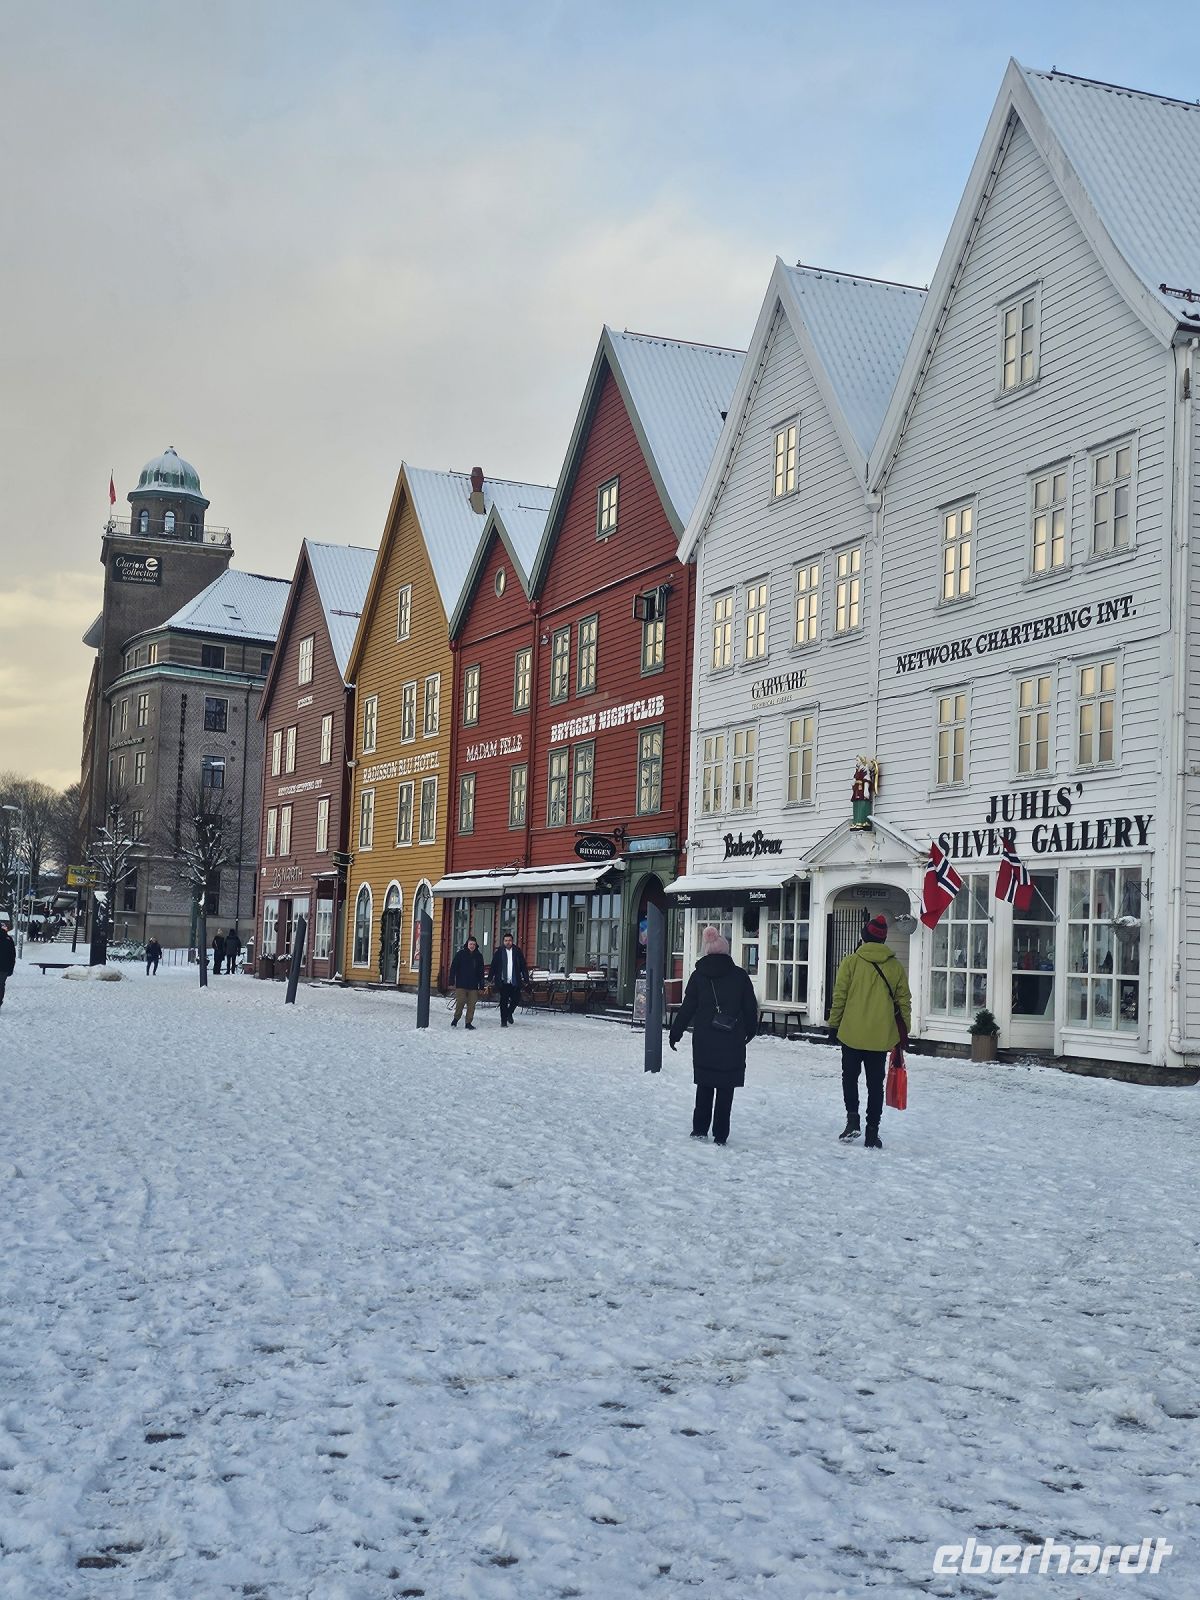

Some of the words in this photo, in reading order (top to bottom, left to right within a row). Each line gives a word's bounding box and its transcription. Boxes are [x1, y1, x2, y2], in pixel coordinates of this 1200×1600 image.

[116, 556, 144, 569] Clarion
[122, 568, 159, 578] Collection
[895, 636, 973, 674] NETWORK
[975, 606, 1092, 655] CHARTERING
[1096, 595, 1137, 625] INT.
[751, 668, 808, 700] GARWARE
[550, 713, 597, 743] BRYGGEN
[597, 695, 665, 731] NIGHTCLUB
[413, 751, 440, 773] HOTEL
[466, 740, 498, 762] MADAM
[499, 734, 523, 756] FELLE
[986, 782, 1084, 824] JUHLS'
[579, 847, 612, 856] BRYGGEN
[938, 826, 1017, 859] SILVER
[1031, 814, 1153, 854] GALLERY
